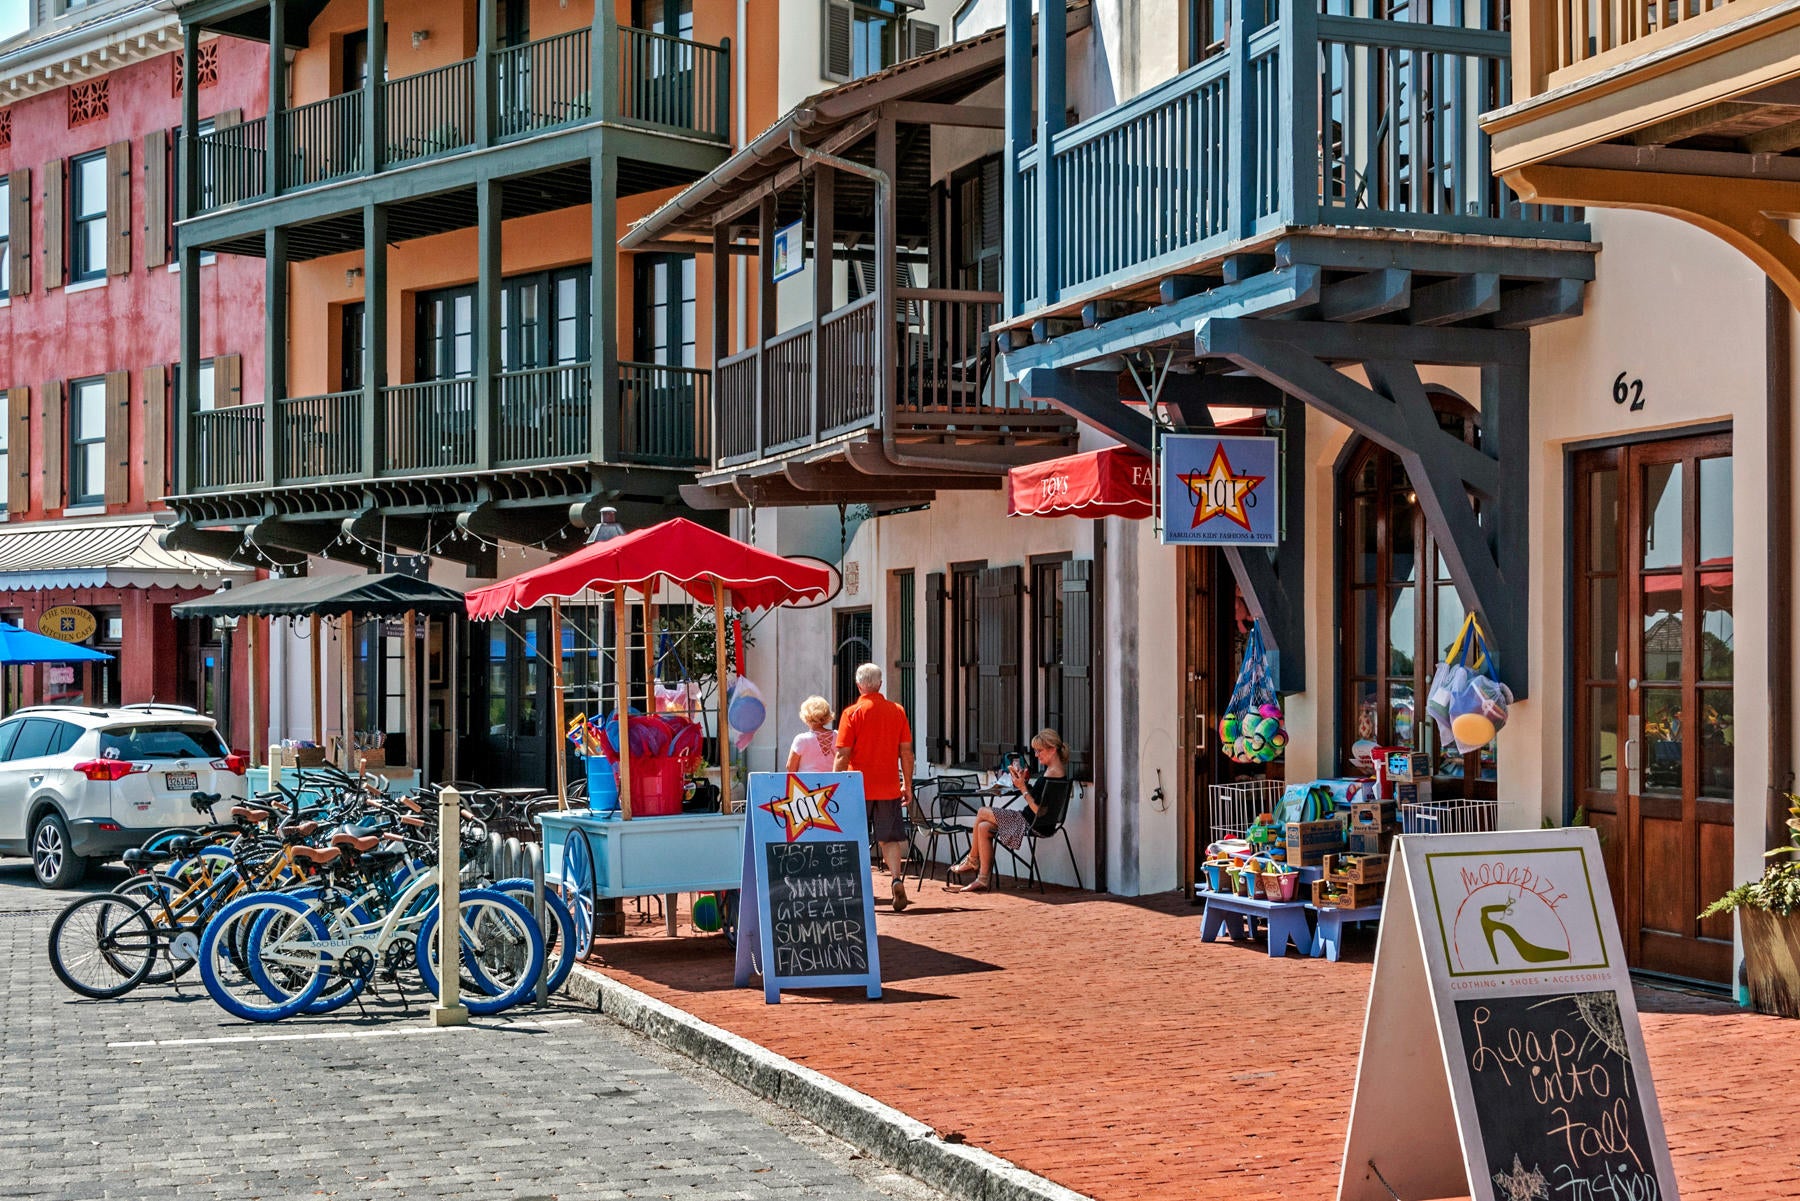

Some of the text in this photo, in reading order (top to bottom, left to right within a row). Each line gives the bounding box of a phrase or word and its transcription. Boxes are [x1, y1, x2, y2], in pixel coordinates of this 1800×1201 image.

[1613, 371, 1645, 412] 62
[1040, 475, 1069, 498] TOYS
[1188, 468, 1257, 517] Gigi's
[43, 607, 93, 622] THE SUMMER
[41, 623, 75, 641] KITCHEN
[770, 783, 840, 831] Gigi's
[772, 843, 849, 874] 75% OFF
[830, 856, 849, 867] OF
[777, 897, 854, 921] GREAT
[775, 920, 864, 944] SUMMER
[777, 944, 867, 975] FASHIONS
[1451, 973, 1613, 990] CLOTHING SHOES ACCESSORIES
[1473, 1006, 1576, 1086] Leap
[1529, 1062, 1610, 1104] into
[1546, 1097, 1644, 1172] Fall
